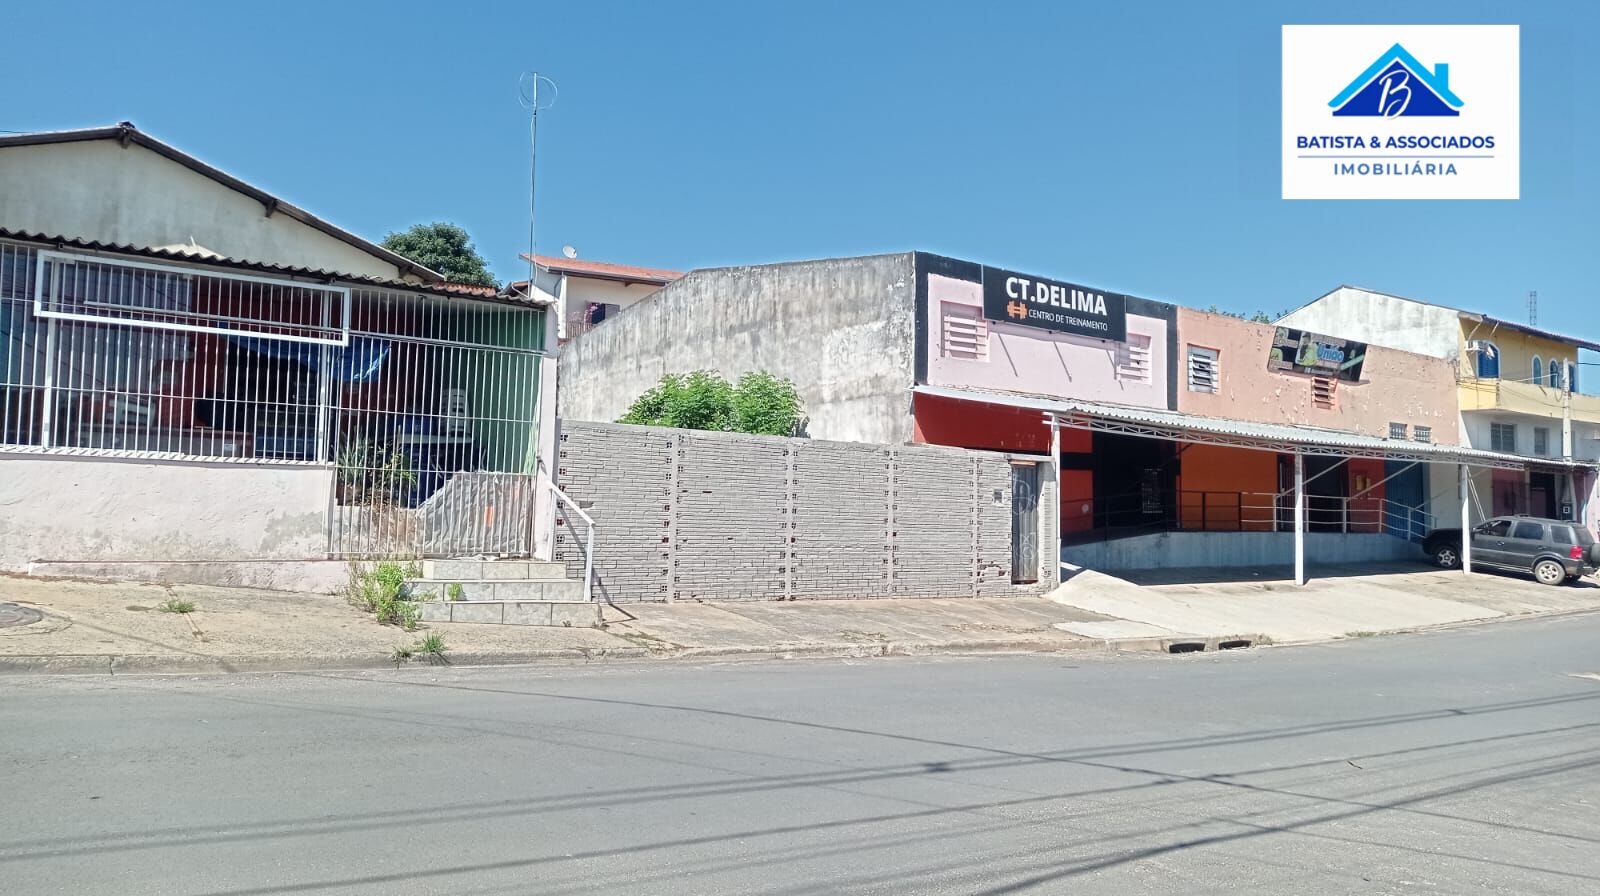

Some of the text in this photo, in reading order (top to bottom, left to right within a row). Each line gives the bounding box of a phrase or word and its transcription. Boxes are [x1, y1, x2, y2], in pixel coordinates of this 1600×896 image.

[1005, 276, 1108, 316] CT.DELIMA
[1028, 309, 1108, 331] CENTRO DE TREINAMENTO
